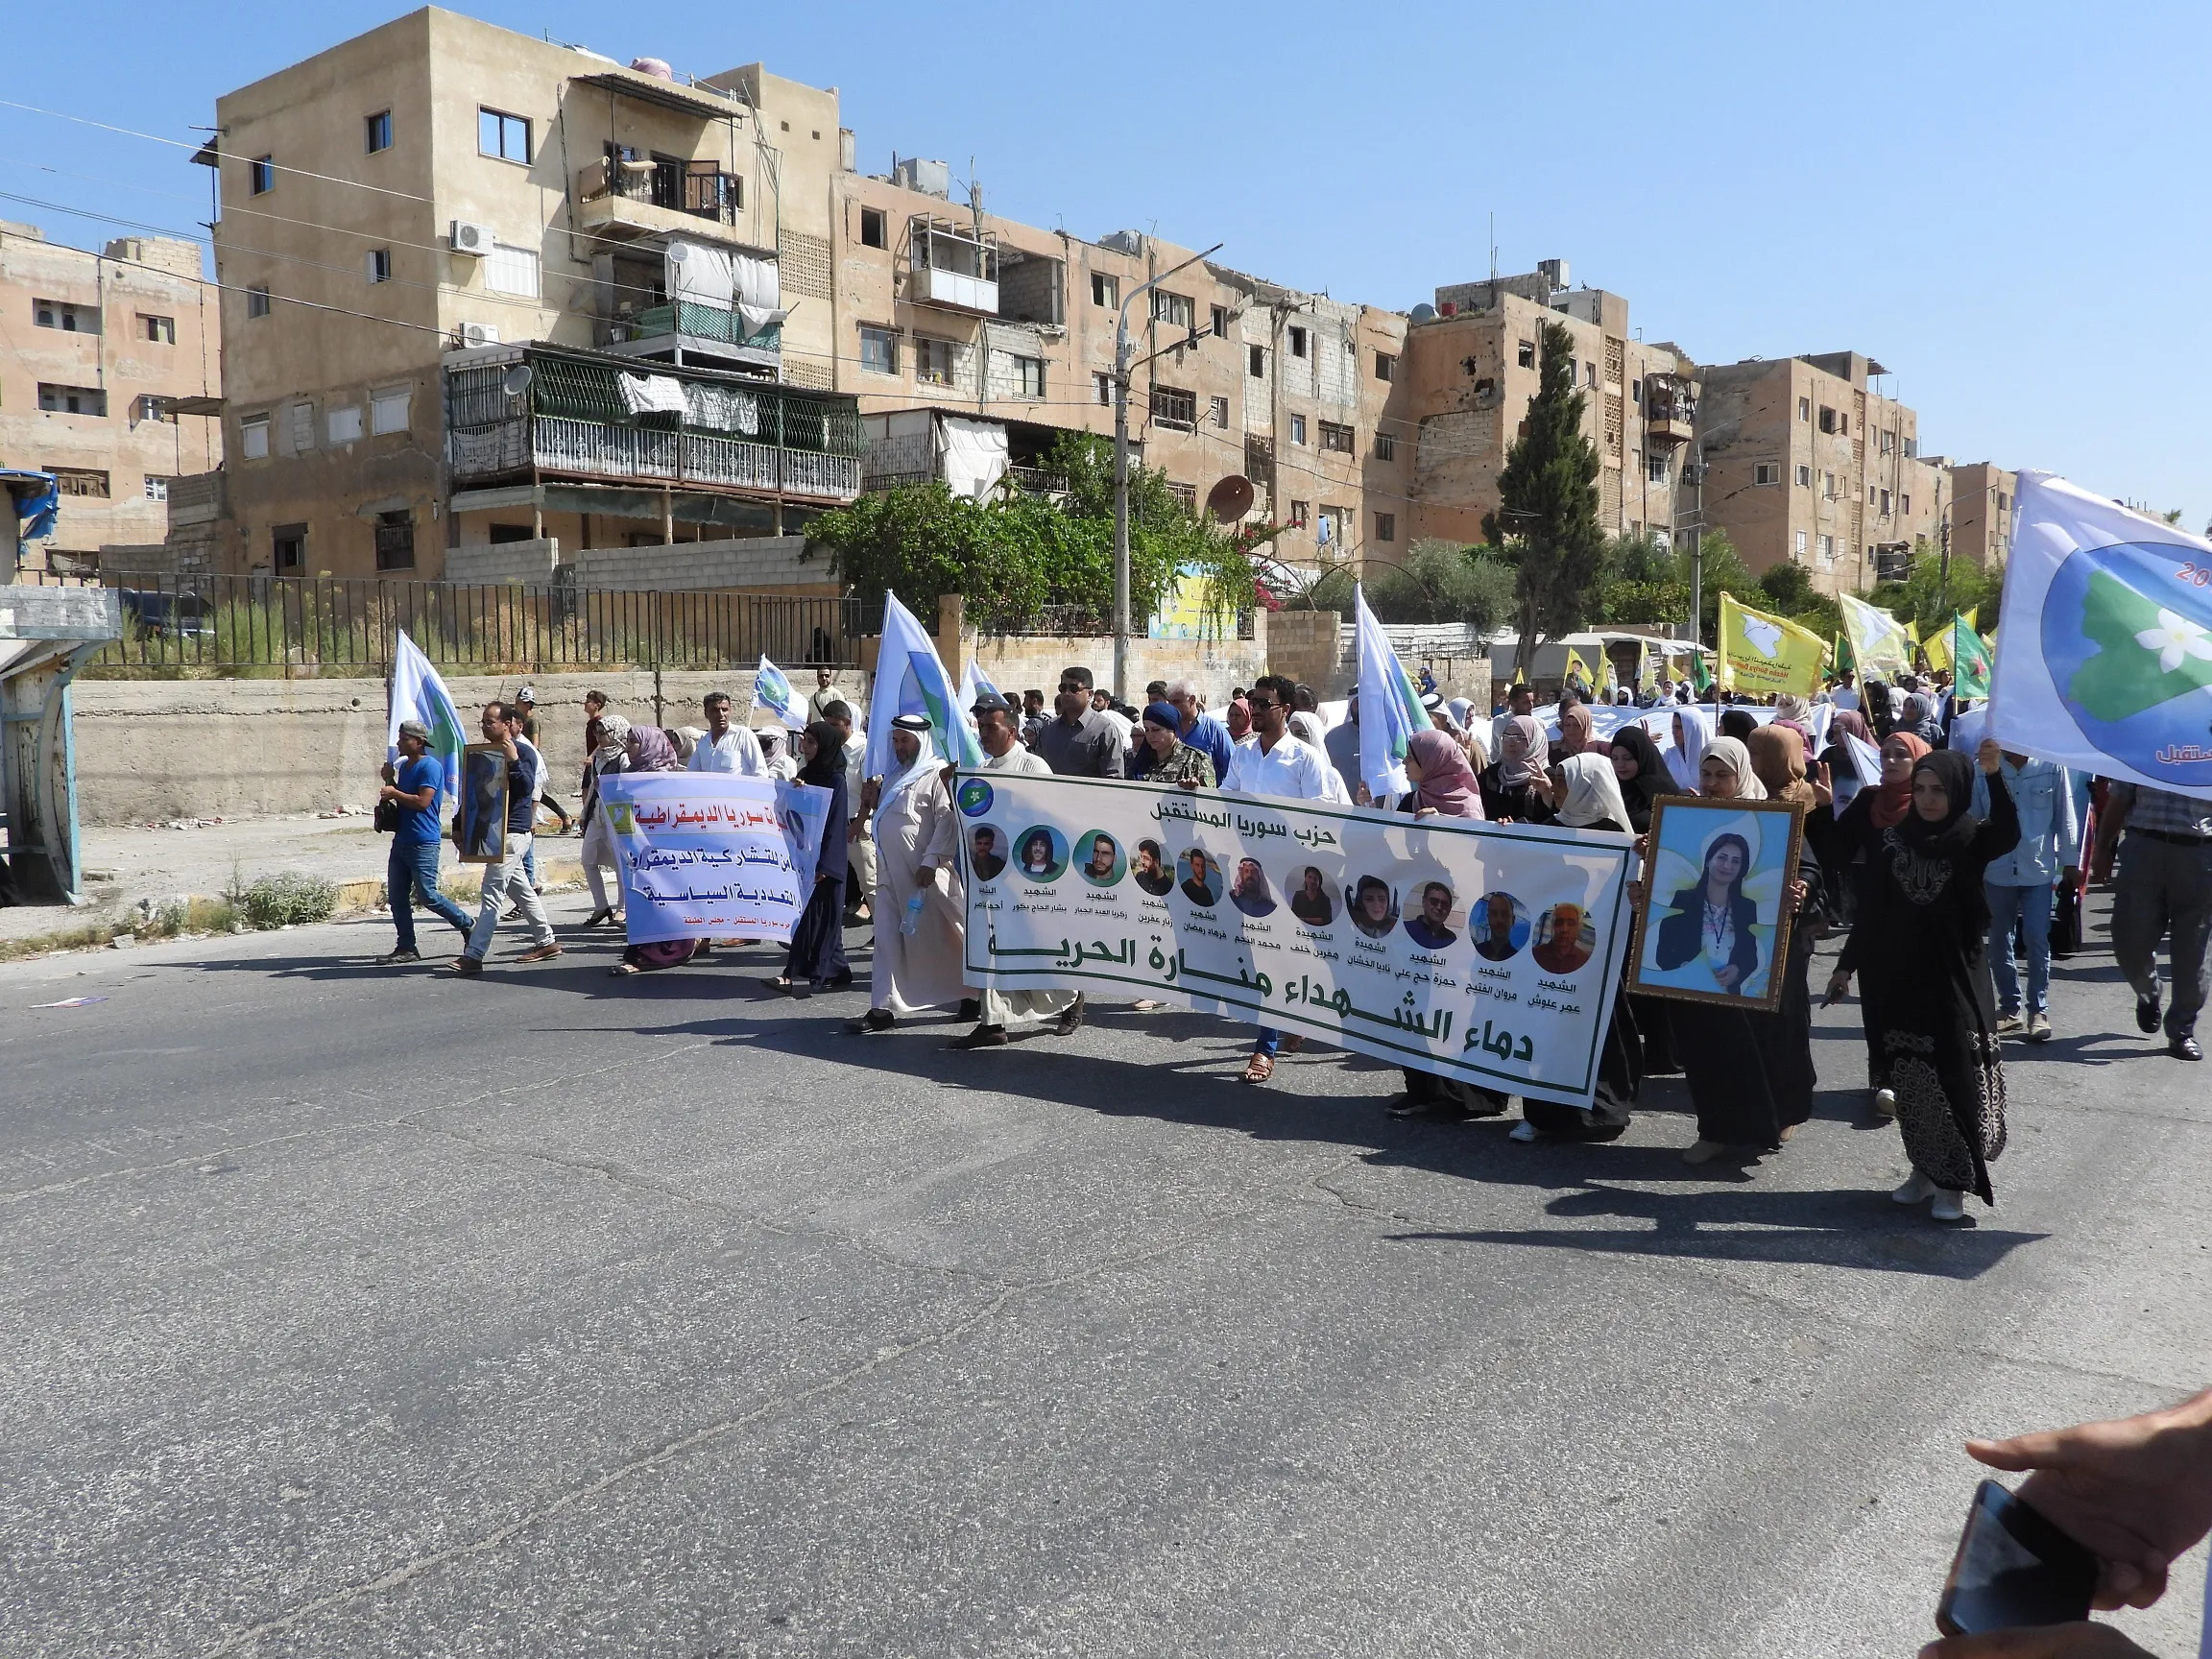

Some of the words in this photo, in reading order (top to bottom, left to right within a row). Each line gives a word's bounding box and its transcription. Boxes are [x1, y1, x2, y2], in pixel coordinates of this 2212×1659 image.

[2175, 562, 2212, 588] 20
[634, 803, 724, 830] الديمقراطية
[724, 804, 763, 829] سوريا
[1149, 802, 1232, 830] المستقبل
[1237, 814, 1287, 839] سوريا
[1293, 825, 1337, 848] حزب
[626, 849, 699, 872] الديمقراط
[697, 846, 779, 869] للتشاركية
[642, 883, 733, 906] السياسية
[1023, 885, 1057, 897] الشهيد
[1086, 890, 1118, 902] الشهيد
[1031, 904, 1049, 913] الحاج
[1051, 902, 1068, 913] بشار
[1142, 899, 1168, 910] الشهيد
[1094, 908, 1111, 917] العبد
[1111, 910, 1128, 920] زكريا
[1190, 909, 1217, 922] الشهيد
[733, 915, 759, 926] المستقبل
[1138, 914, 1161, 925] عفرين
[1183, 922, 1206, 934] رمضان
[1207, 927, 1227, 939] فرهاد
[1240, 921, 1271, 932] الشهيد
[1296, 926, 1334, 942] الشهيدة
[987, 922, 1137, 969] الحرية
[1235, 936, 1256, 946] النجم
[1257, 940, 1281, 950] محمد
[1355, 936, 1386, 953] الشهيدة
[1290, 943, 1311, 954] خلف
[1312, 948, 1339, 960] هفرين
[1148, 933, 1273, 998] منارة
[1347, 953, 1375, 968] الخشان
[1409, 953, 1447, 967] الشهيد
[1376, 962, 1390, 974] ناديا
[1394, 968, 1411, 981] علي
[1478, 966, 1511, 979] الشهيد
[1413, 972, 1431, 984] حج
[1433, 972, 1456, 988] حمزة
[1465, 982, 1493, 995] الفتيح
[1537, 978, 1577, 993] الشهيد
[1494, 988, 1518, 1001] مروان
[1527, 994, 1557, 1009] علوش
[1285, 974, 1454, 1045] الشهداء
[1559, 1003, 1581, 1014] عمر
[1463, 1020, 1534, 1063] دماء
